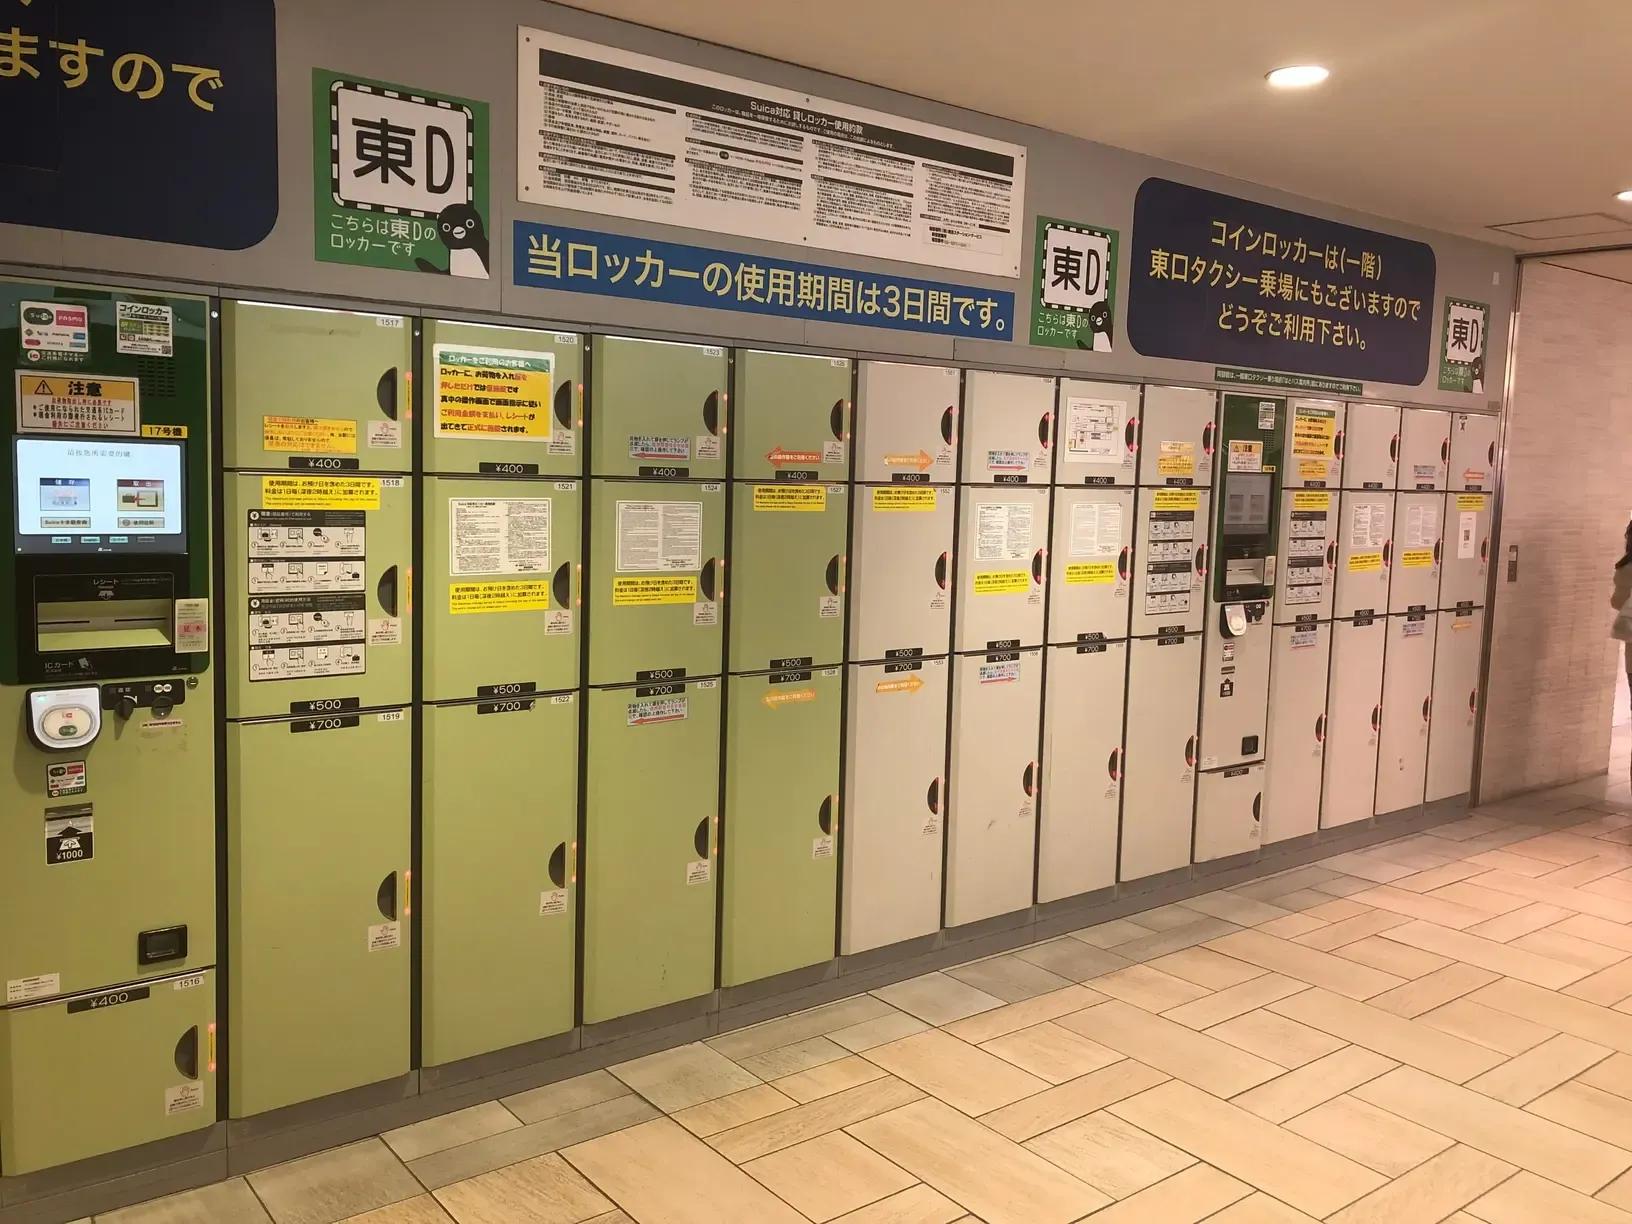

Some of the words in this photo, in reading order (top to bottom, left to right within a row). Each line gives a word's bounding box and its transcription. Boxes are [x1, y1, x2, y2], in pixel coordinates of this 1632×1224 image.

[0, 27, 224, 111] ますので
[750, 101, 791, 119] Suica対応
[792, 109, 864, 135] 貸しロッカー使用約款
[351, 117, 455, 195] 東D
[330, 213, 436, 241] こちらは東Dの
[330, 233, 416, 256] ロッカーです
[1211, 219, 1382, 281] コインロッカーは(一階)
[1052, 245, 1101, 296] 東D
[527, 233, 1006, 332] 当ロッカーの使用期間は3日間です。
[1149, 248, 1421, 322] 東口タクシー乗場にもございますので
[119, 304, 169, 315] コインロッカー
[1037, 311, 1089, 329] こちらは東Dの
[1217, 302, 1368, 351] どうぞご利用下さい。
[1037, 325, 1079, 340] ロッカーです
[1452, 317, 1479, 354] 東D
[67, 381, 102, 397] 注意
[149, 427, 182, 437] 17号機
[308, 459, 341, 469] ¥400
[496, 464, 524, 473] ¥400
[653, 468, 677, 476] ¥400
[787, 472, 807, 480] ¥400
[902, 474, 920, 482] ¥400
[895, 649, 913, 657] ¥500
[44, 661, 74, 669] ICカード
[781, 659, 801, 667] ¥500
[895, 663, 913, 671] ¥700
[649, 670, 673, 679] ¥500
[780, 673, 801, 682] ¥700
[493, 684, 521, 694] ¥500
[649, 686, 673, 695] ¥700
[309, 700, 341, 711] ¥500
[493, 701, 521, 711] ¥700
[382, 713, 400, 721] 1519
[309, 719, 341, 730] ¥700
[1230, 769, 1243, 777] ¥400
[56, 849, 83, 861] ¥1000
[179, 978, 200, 988] 1516
[90, 992, 129, 1009] ¥400
